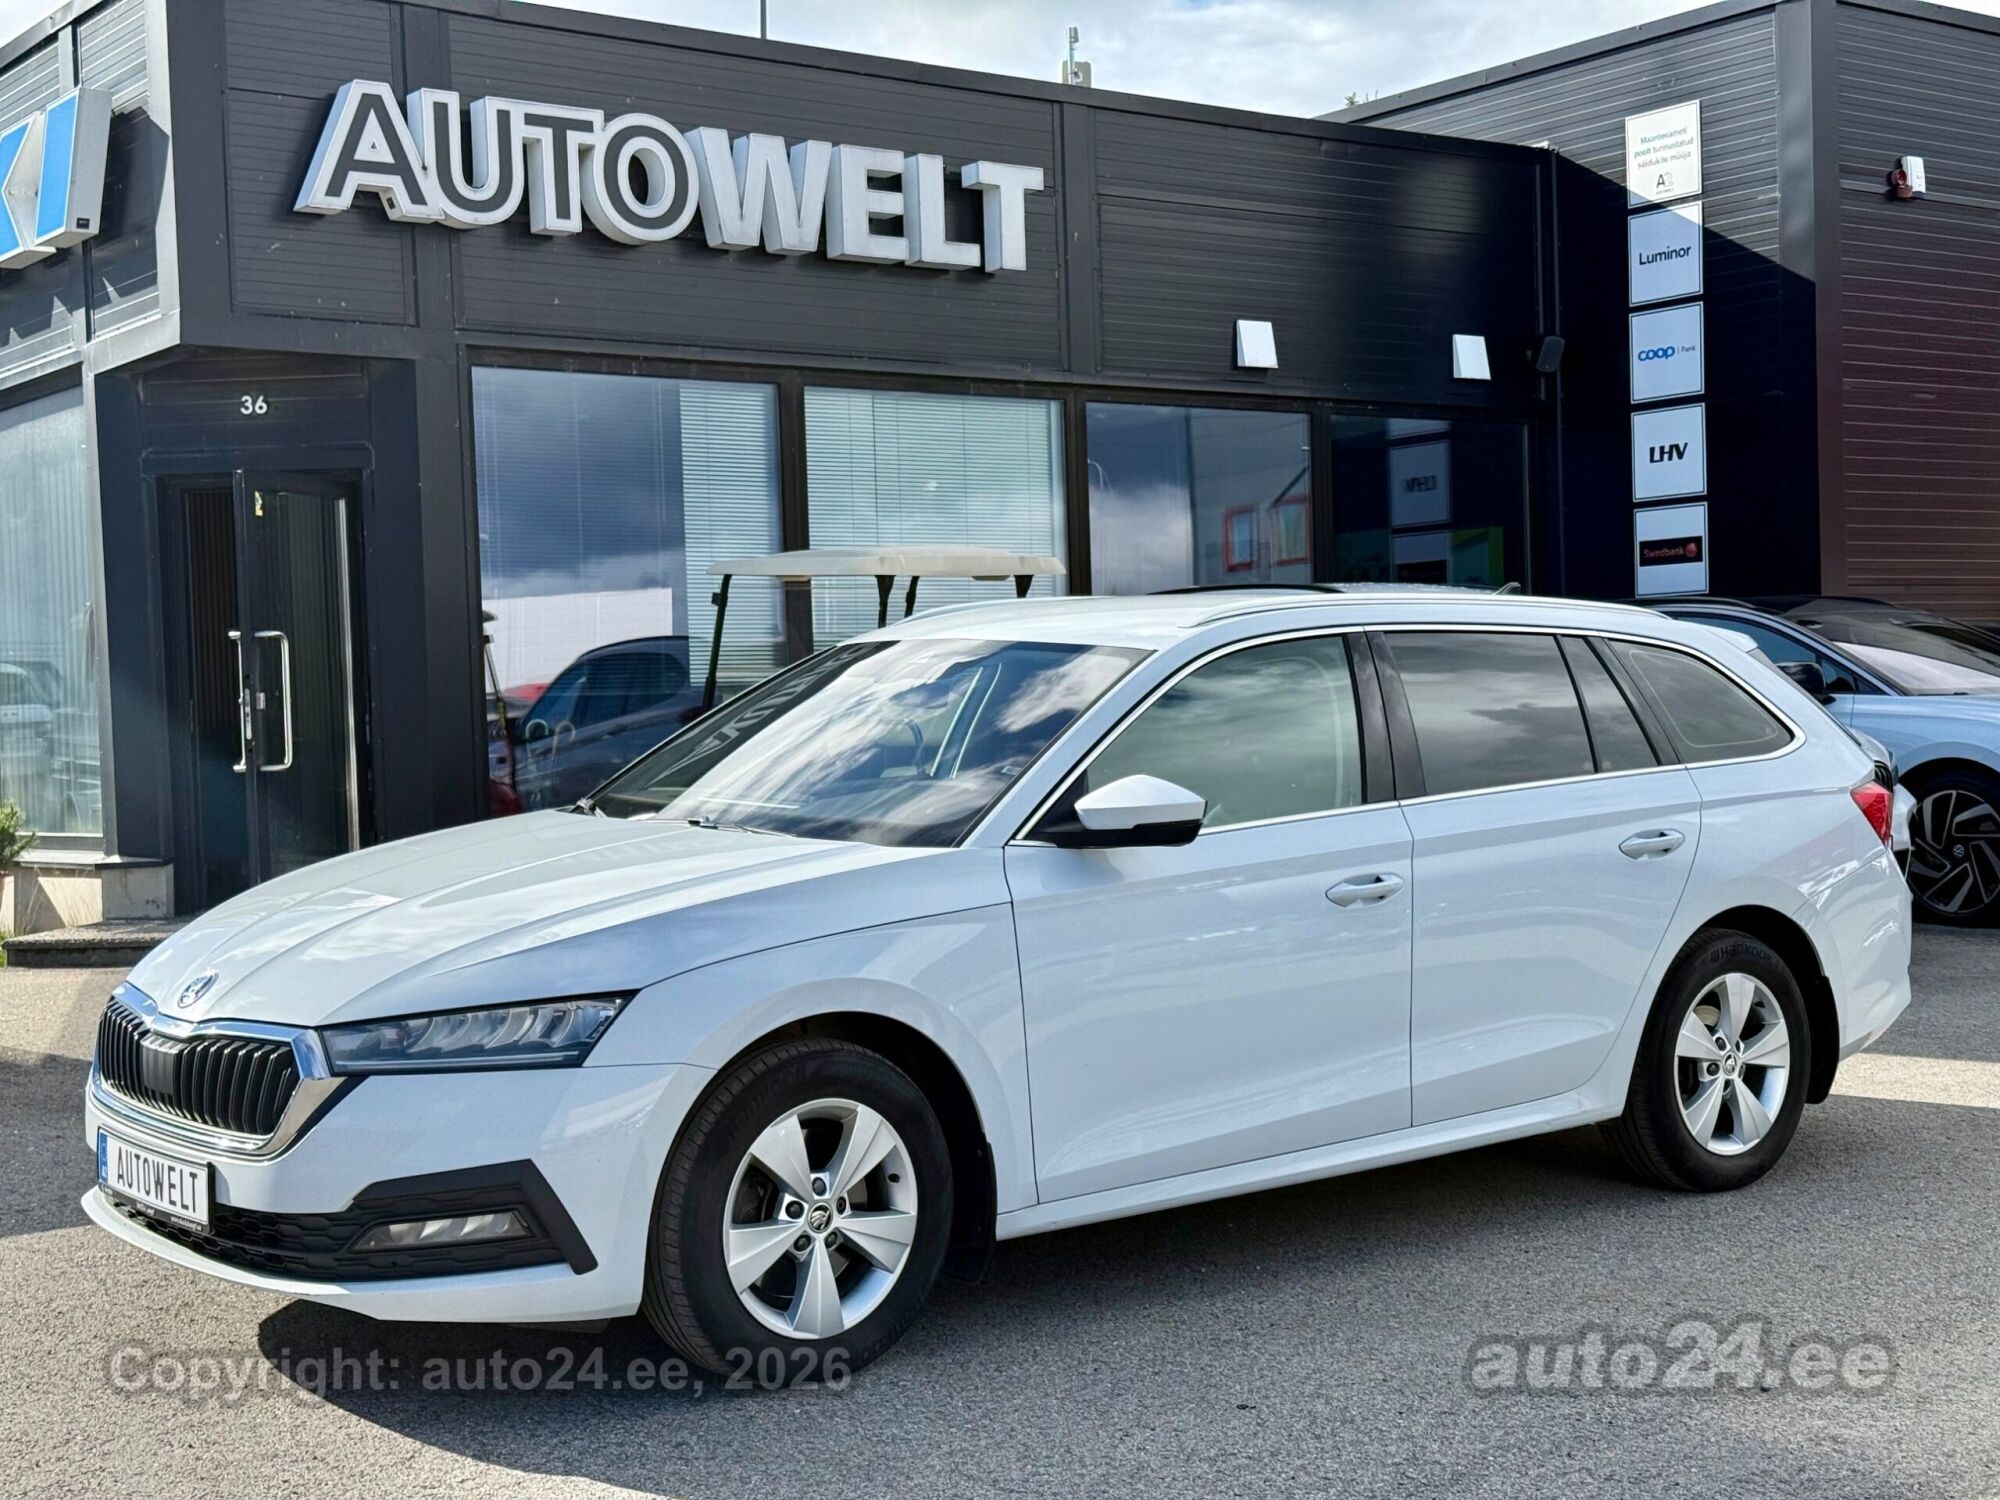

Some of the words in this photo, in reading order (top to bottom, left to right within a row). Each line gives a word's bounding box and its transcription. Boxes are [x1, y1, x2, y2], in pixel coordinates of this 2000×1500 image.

[294, 79, 1044, 273] AUTOWELT
[1638, 245, 1692, 266] Luminor
[1638, 346, 1676, 362] coop
[240, 395, 268, 415] 36
[1649, 442, 1688, 464] LHV
[1643, 546, 1684, 559] Swedbank
[117, 1146, 198, 1213] AUTOWELT
